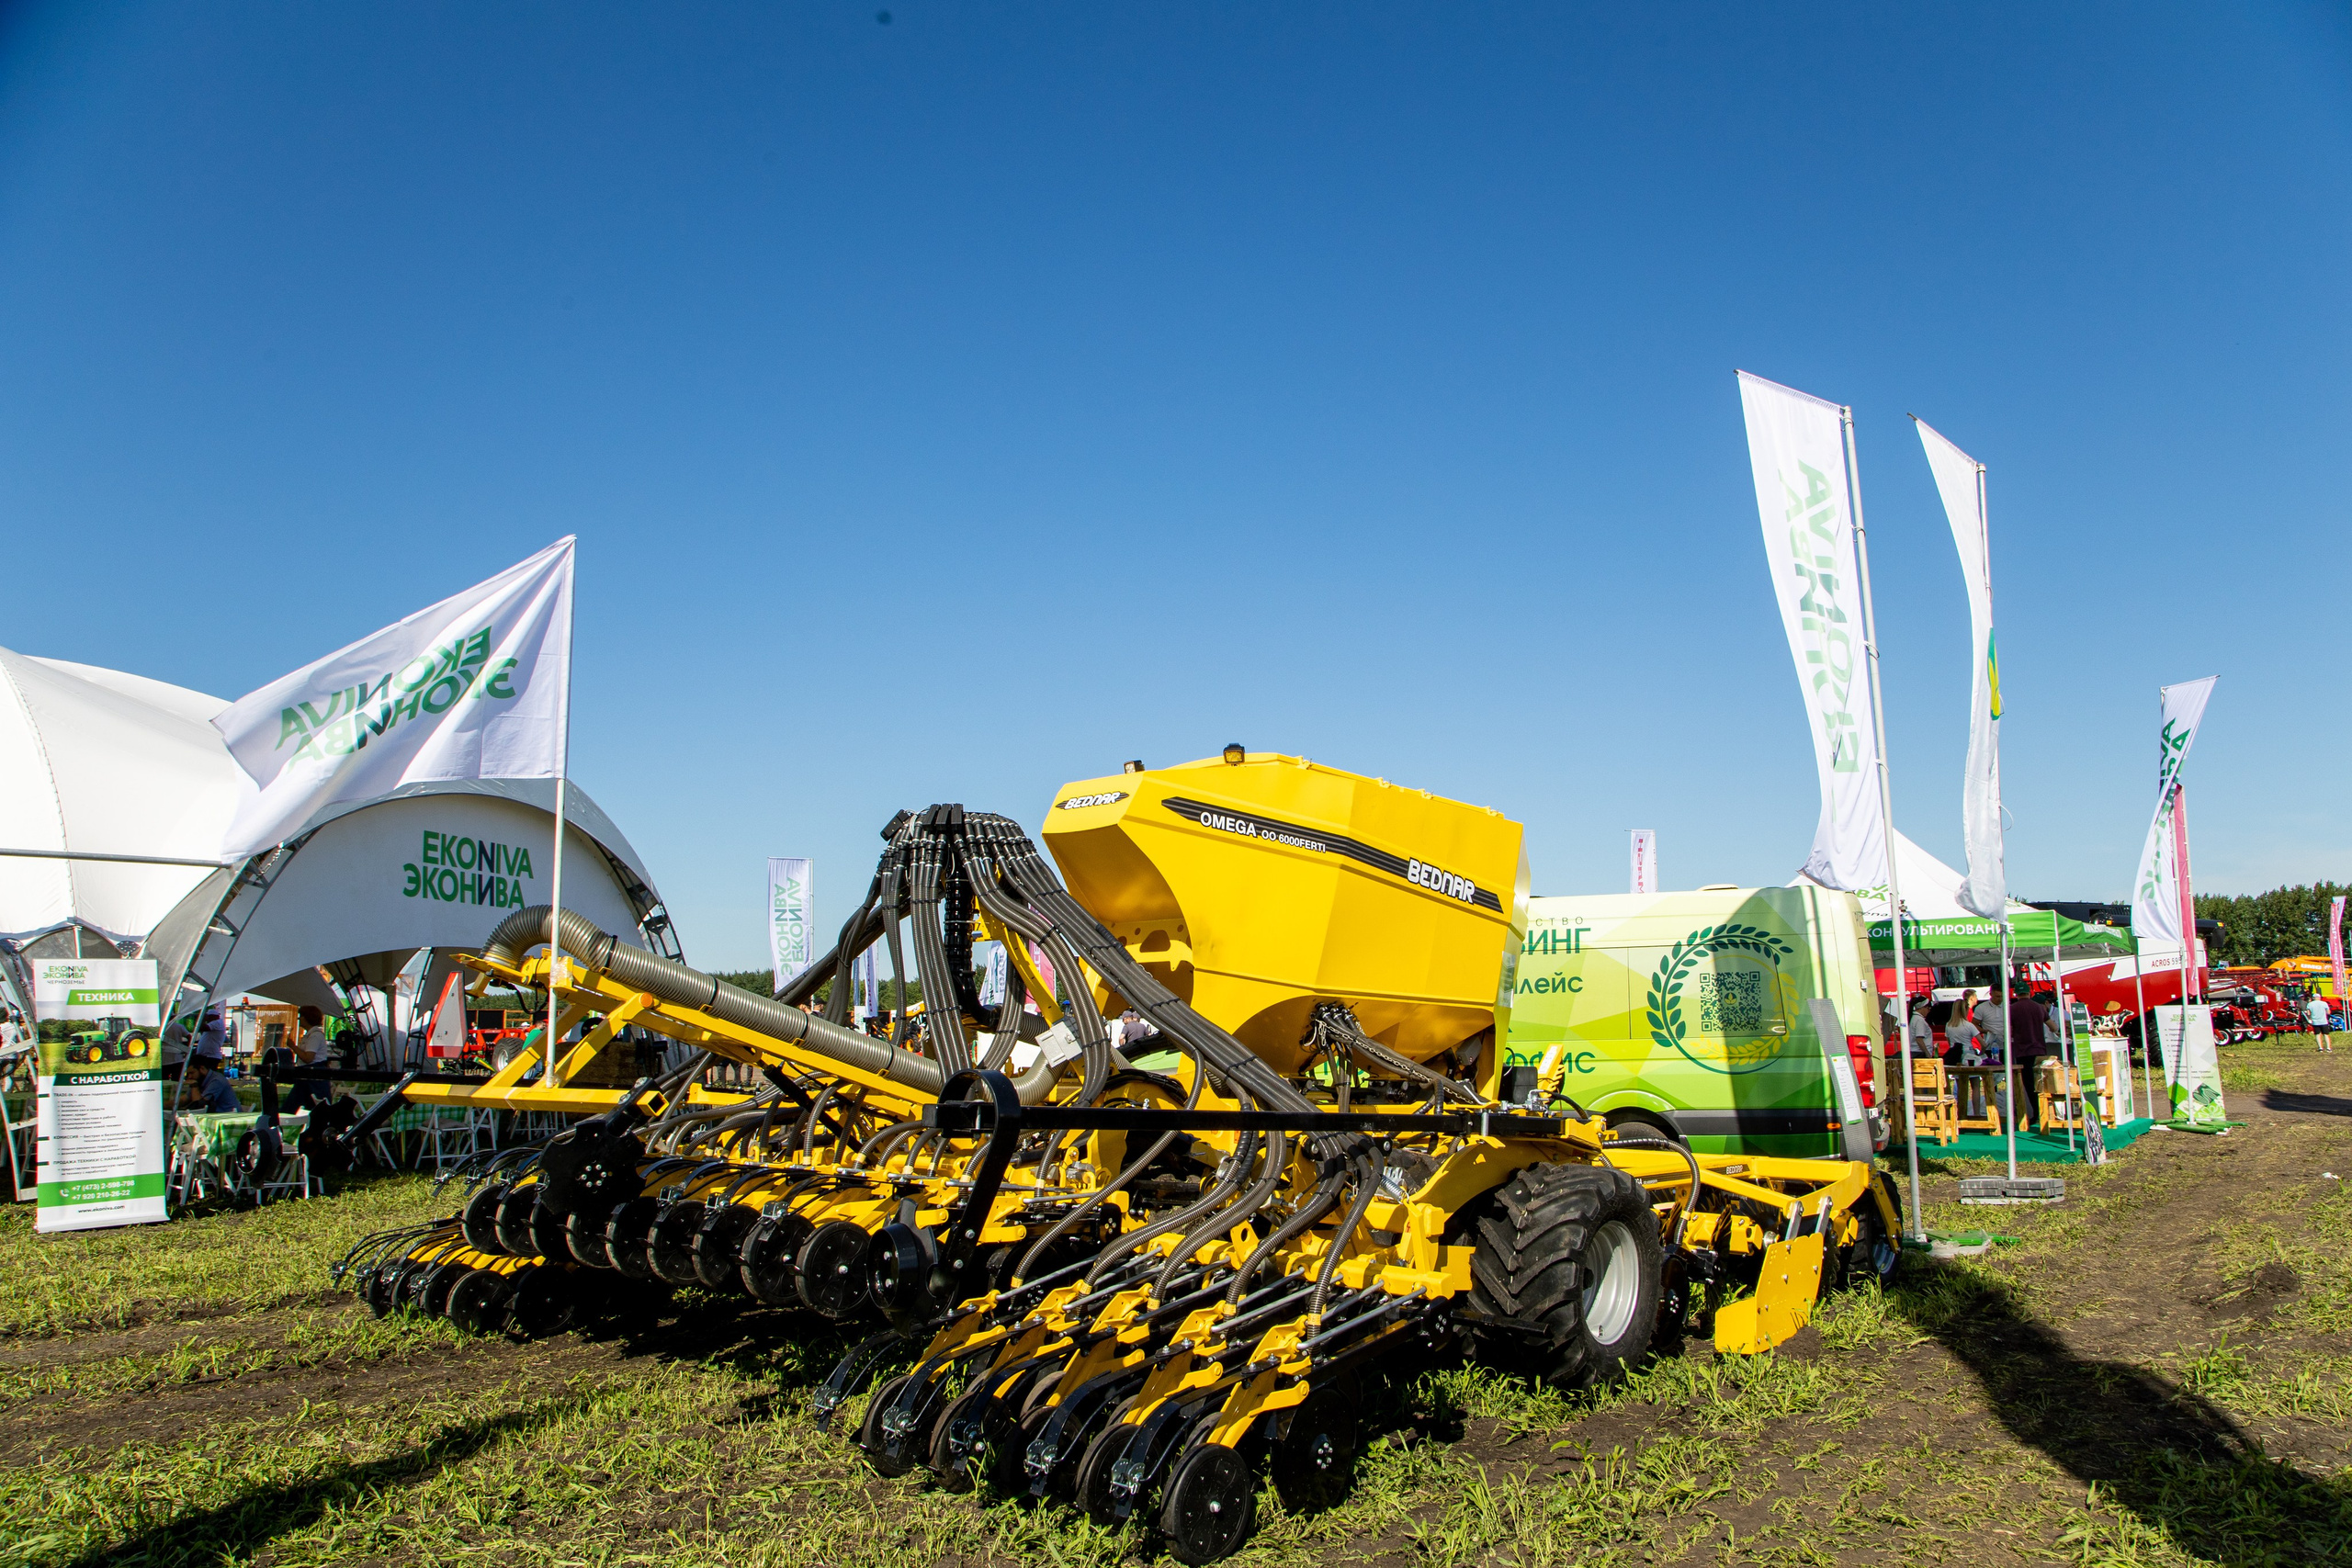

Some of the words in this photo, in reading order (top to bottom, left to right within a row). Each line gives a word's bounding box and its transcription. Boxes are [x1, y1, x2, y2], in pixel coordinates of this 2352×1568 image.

[1064, 791, 1120, 810] BEDNAR
[1200, 811, 1257, 838] OMEGA
[1279, 834, 1327, 853] 6000FERTI
[423, 829, 534, 879] EKONIVA
[402, 863, 525, 909] ЭКОНИВА
[1407, 857, 1475, 905] BEDNAR
[1528, 916, 1584, 927] СТВО
[1867, 923, 2015, 938] КОНУЛЬТИРОВАНЕ
[1521, 928, 1591, 955] ИНГ
[2151, 958, 2170, 967] ACROS
[1514, 972, 1584, 994] лейс
[76, 992, 134, 1001] ТЕХНИКА
[79, 1071, 149, 1083] НАРАБОТКОЙ
[83, 1183, 99, 1191] (473)
[78, 1205, 125, 1213] www.ekoniva.com
